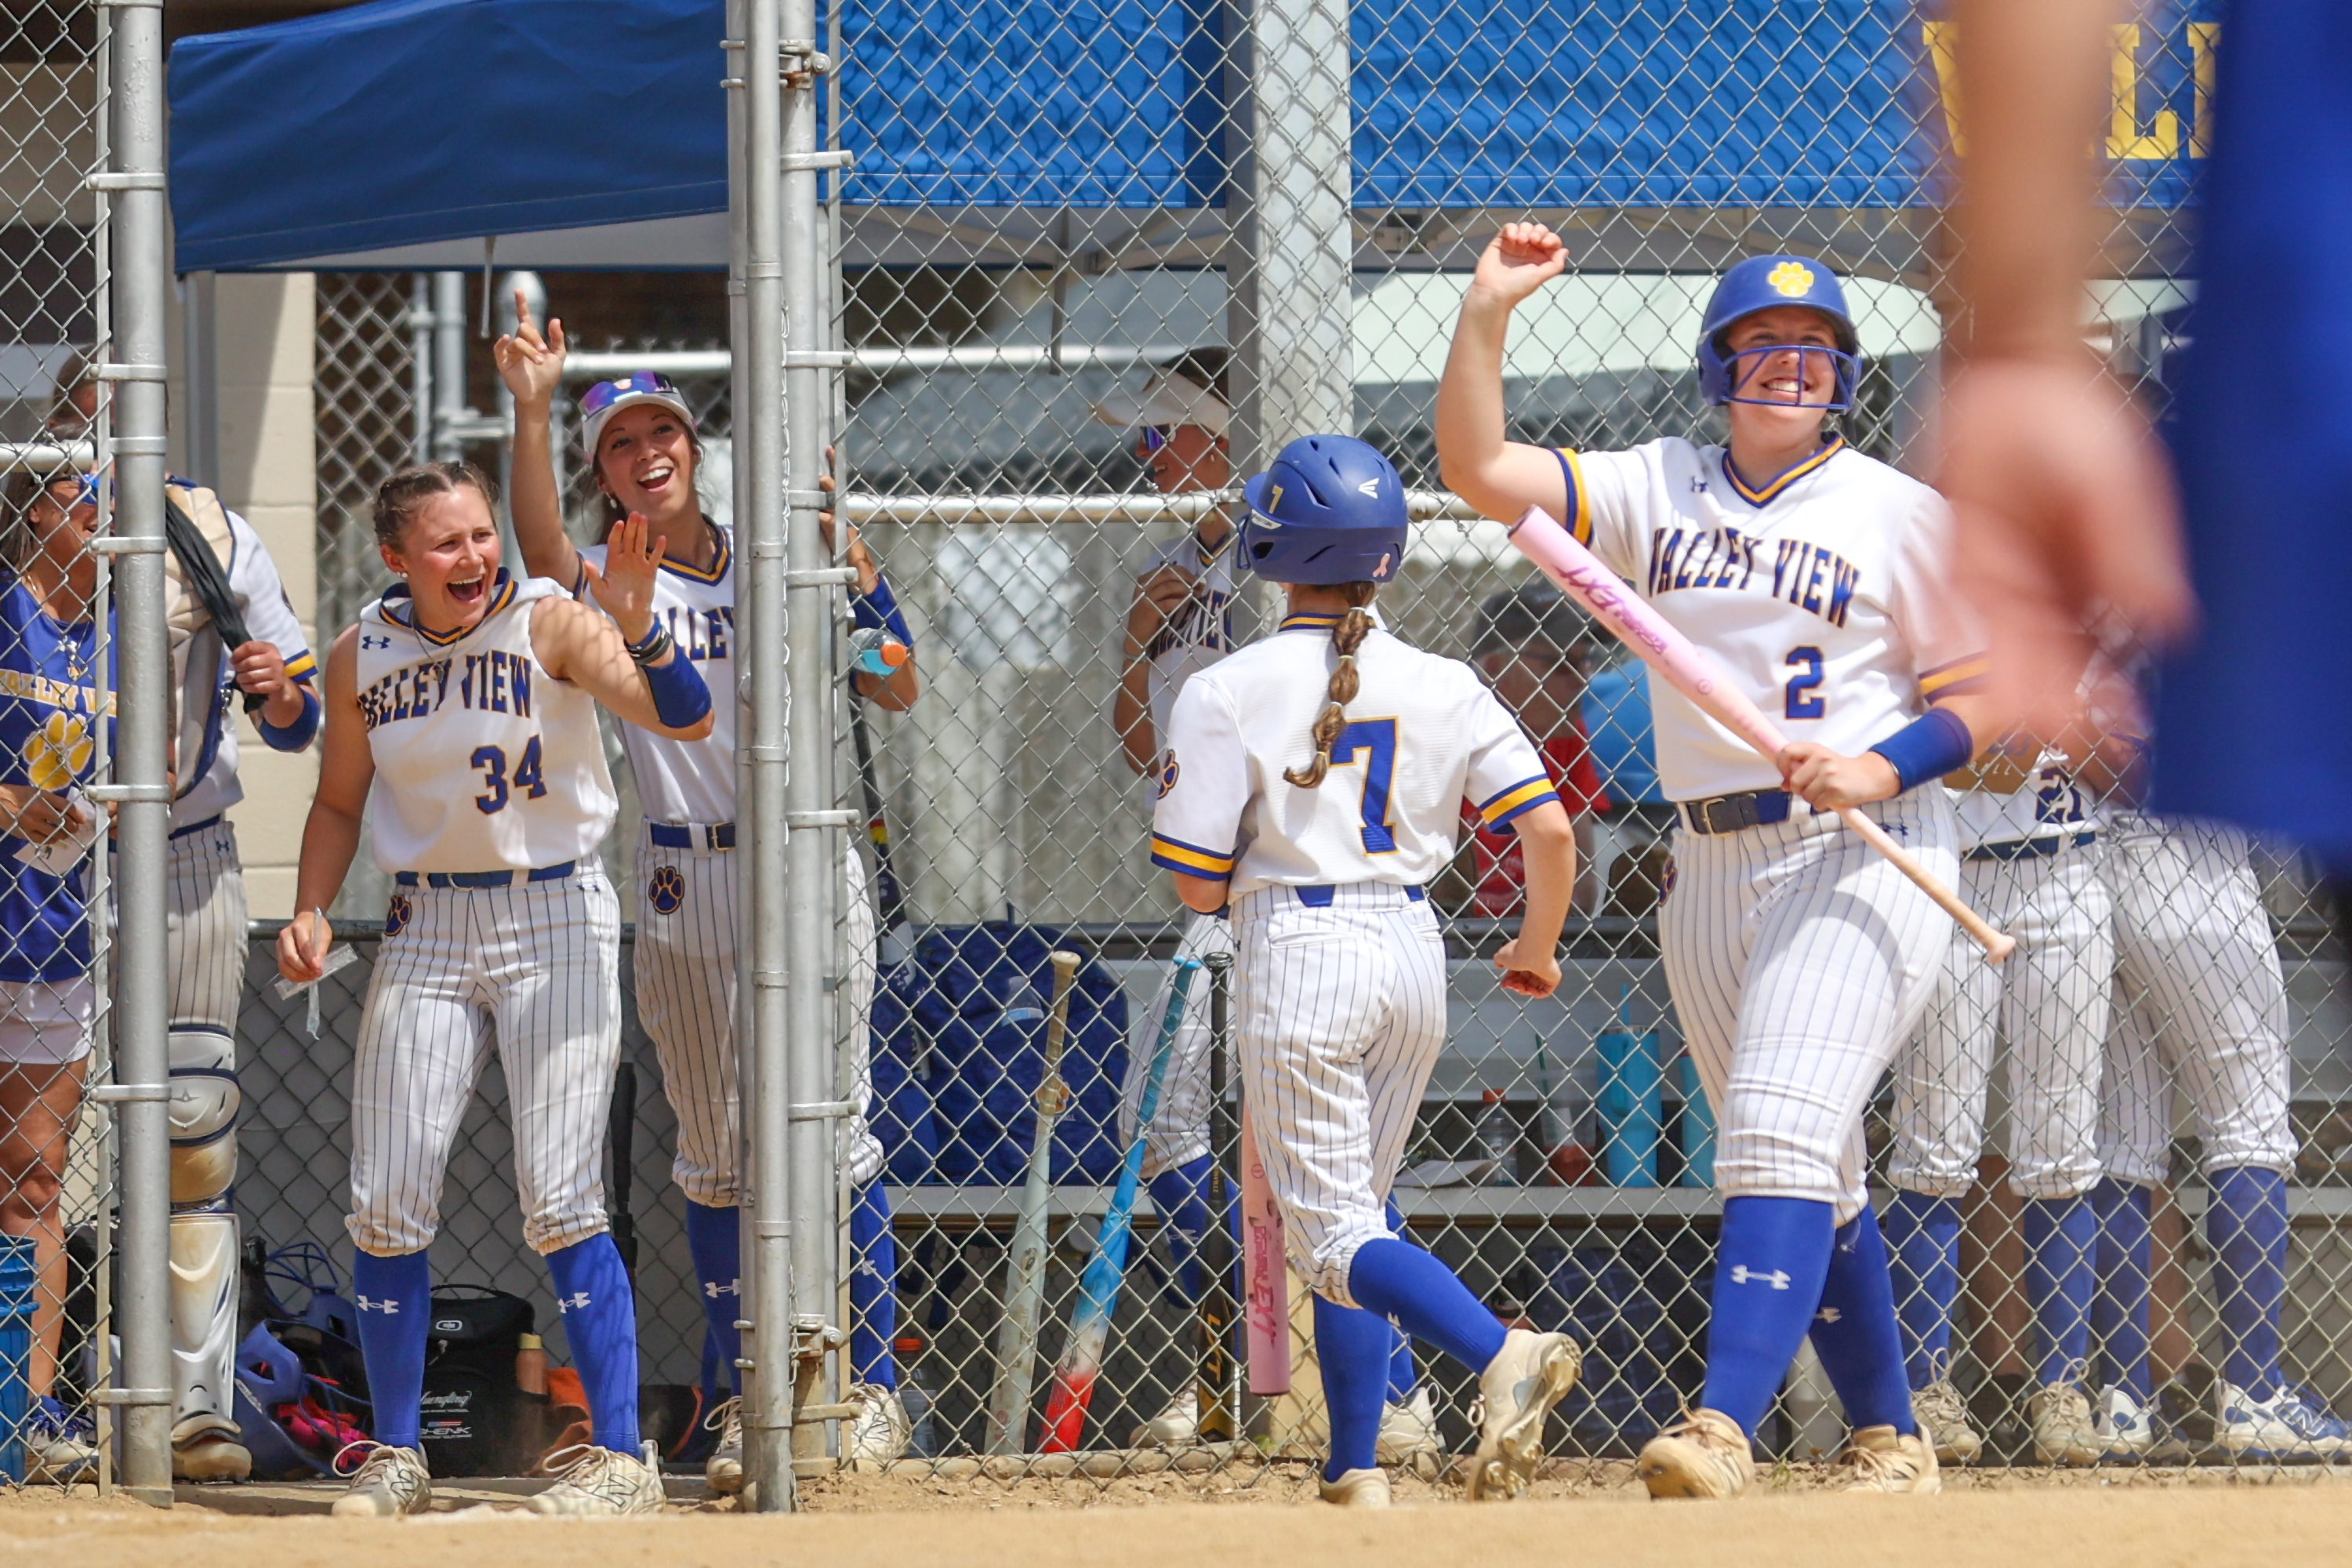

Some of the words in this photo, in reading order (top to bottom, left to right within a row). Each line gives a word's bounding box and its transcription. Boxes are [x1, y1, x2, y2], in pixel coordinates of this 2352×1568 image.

[1269, 485, 1283, 514] 7
[1648, 526, 1765, 598] VALLEY
[1772, 538, 1861, 630] VIEW
[461, 649, 532, 720] VIEW
[1784, 644, 1825, 721] 2
[470, 731, 549, 817] 34
[1327, 715, 1402, 858] 7
[2035, 764, 2086, 825] 21
